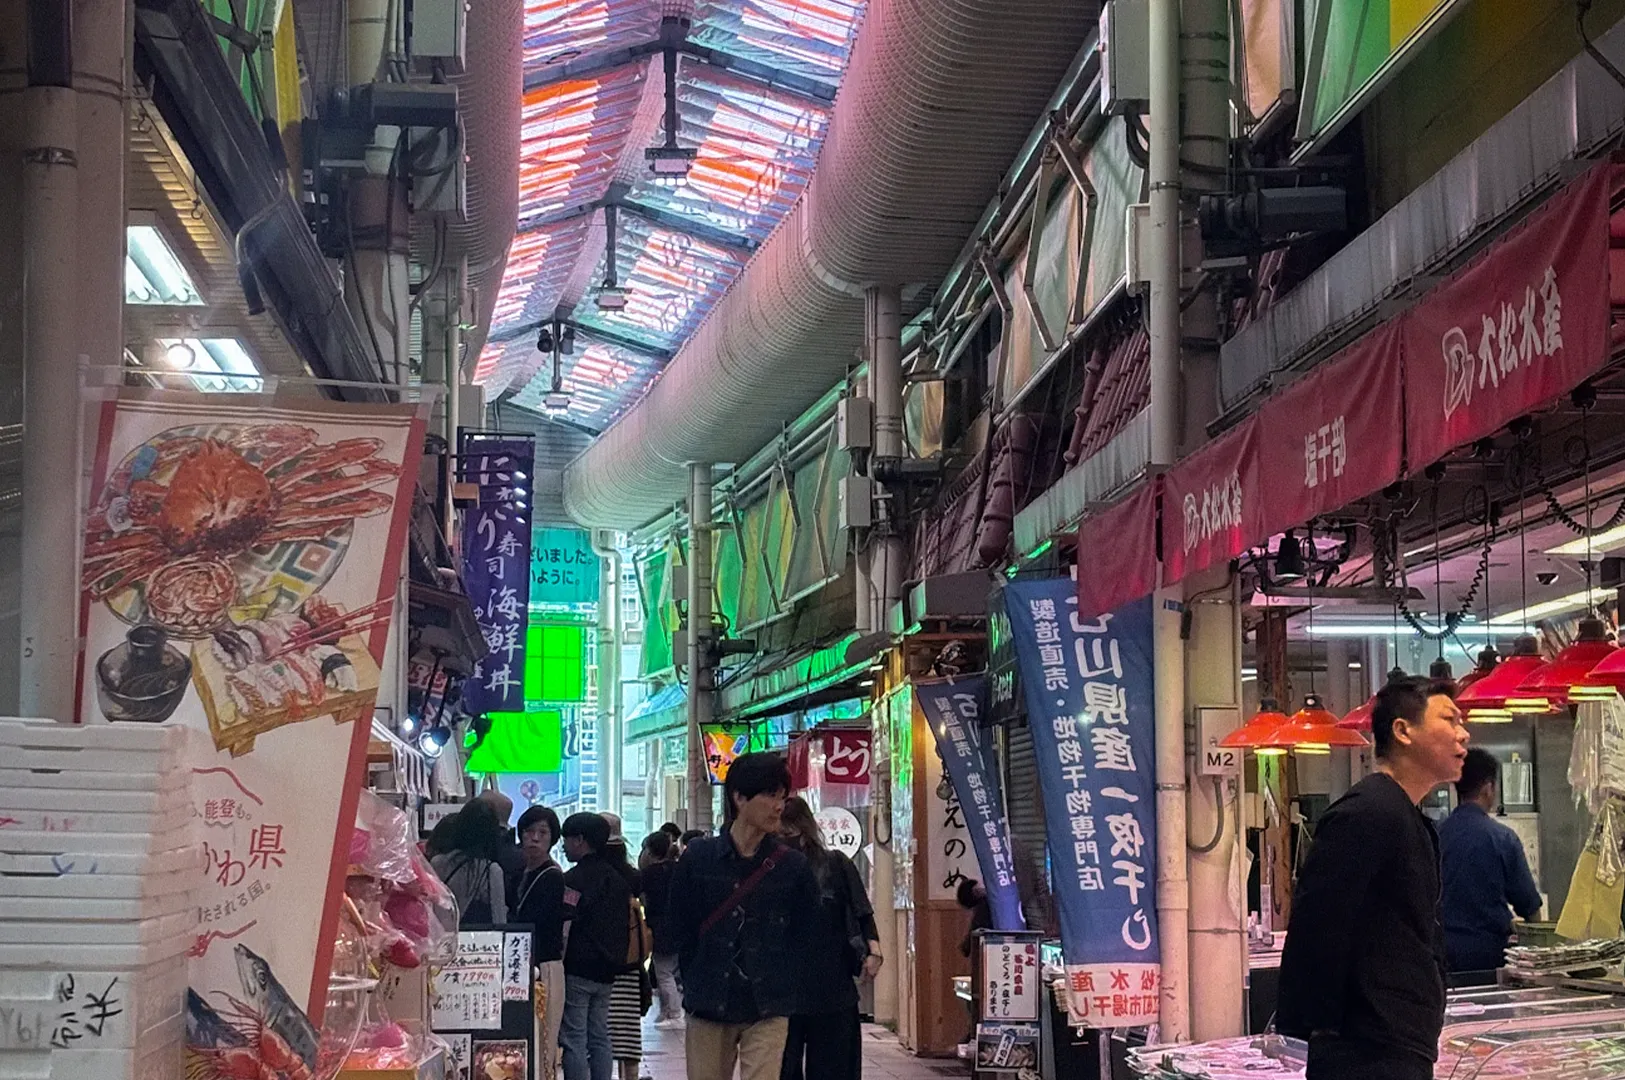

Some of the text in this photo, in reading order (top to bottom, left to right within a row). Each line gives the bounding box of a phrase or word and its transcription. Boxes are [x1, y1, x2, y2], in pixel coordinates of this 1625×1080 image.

[1304, 415, 1347, 488] 塩干部
[1207, 752, 1234, 766] M2
[198, 879, 272, 923] たされる国。
